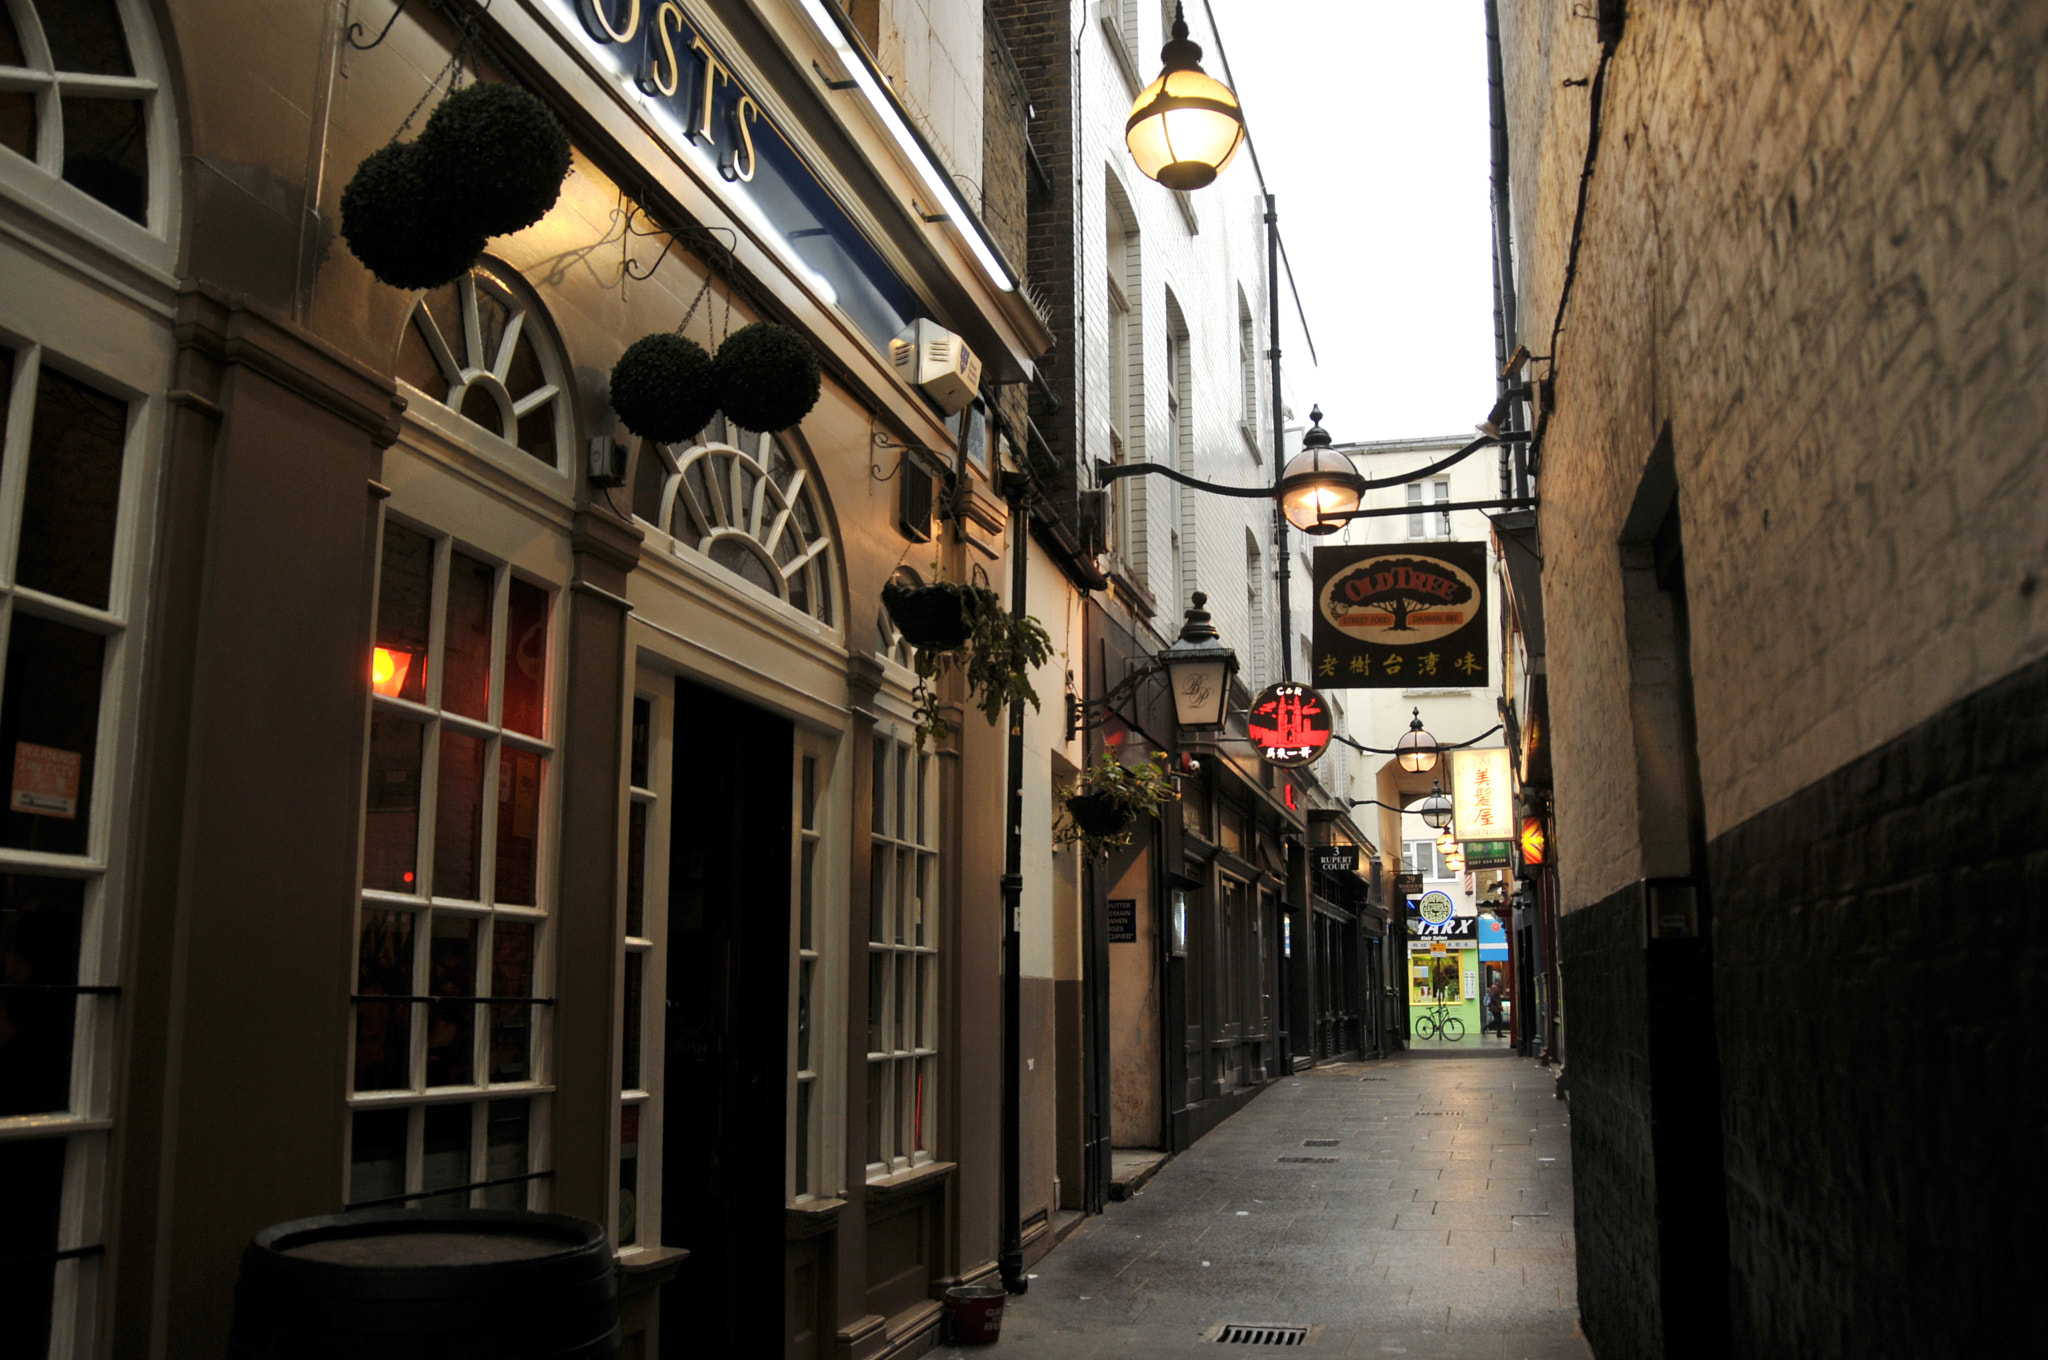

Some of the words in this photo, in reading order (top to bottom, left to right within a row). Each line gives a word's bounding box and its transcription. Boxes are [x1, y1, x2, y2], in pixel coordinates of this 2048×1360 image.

[1343, 616, 1368, 625] STREET
[1371, 616, 1390, 624] FOOD
[1333, 846, 1340, 856] 3
[1320, 856, 1353, 864] RUPERT
[1405, 876, 1415, 884] 29
